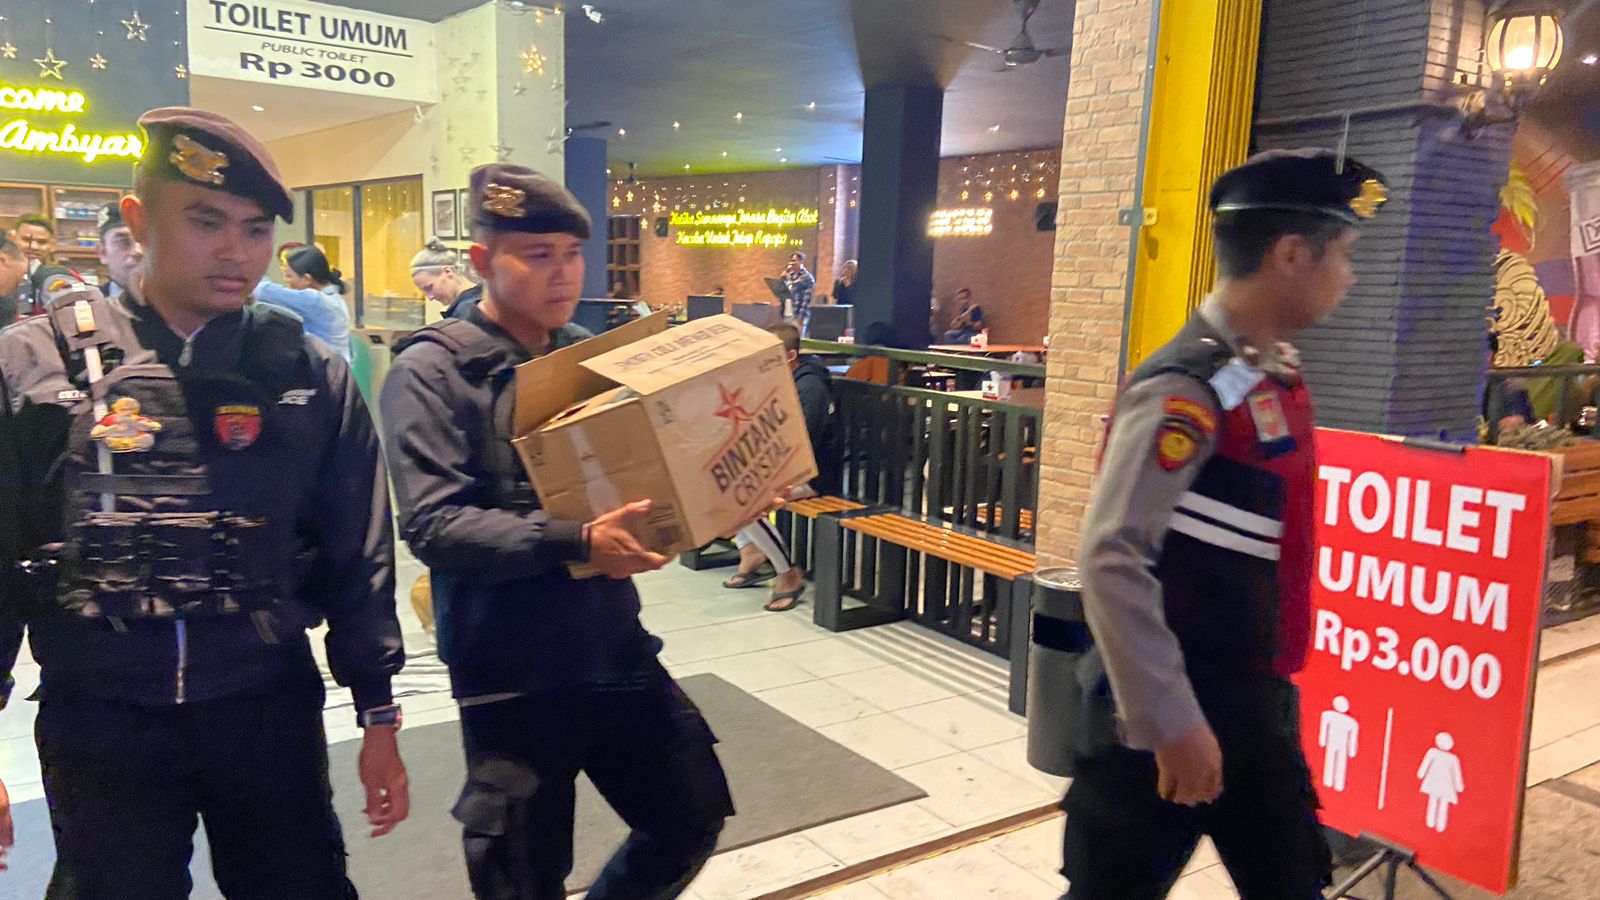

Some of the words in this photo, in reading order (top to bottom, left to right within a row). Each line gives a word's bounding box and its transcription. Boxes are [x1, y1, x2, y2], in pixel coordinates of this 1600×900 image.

[209, 0, 311, 36] TOILET
[320, 16, 408, 51] UMUM
[261, 42, 315, 57] PUBLIC
[319, 49, 368, 64] TOILET
[239, 52, 293, 79] Rp
[300, 61, 396, 88] 3000
[0, 119, 142, 163] Ambyar
[711, 398, 788, 494] BINTANG
[734, 436, 792, 506] CRYSTAL
[1318, 465, 1527, 559] TOILET
[1318, 546, 1510, 632] UMUM
[1314, 609, 1502, 699] Rp3.000
